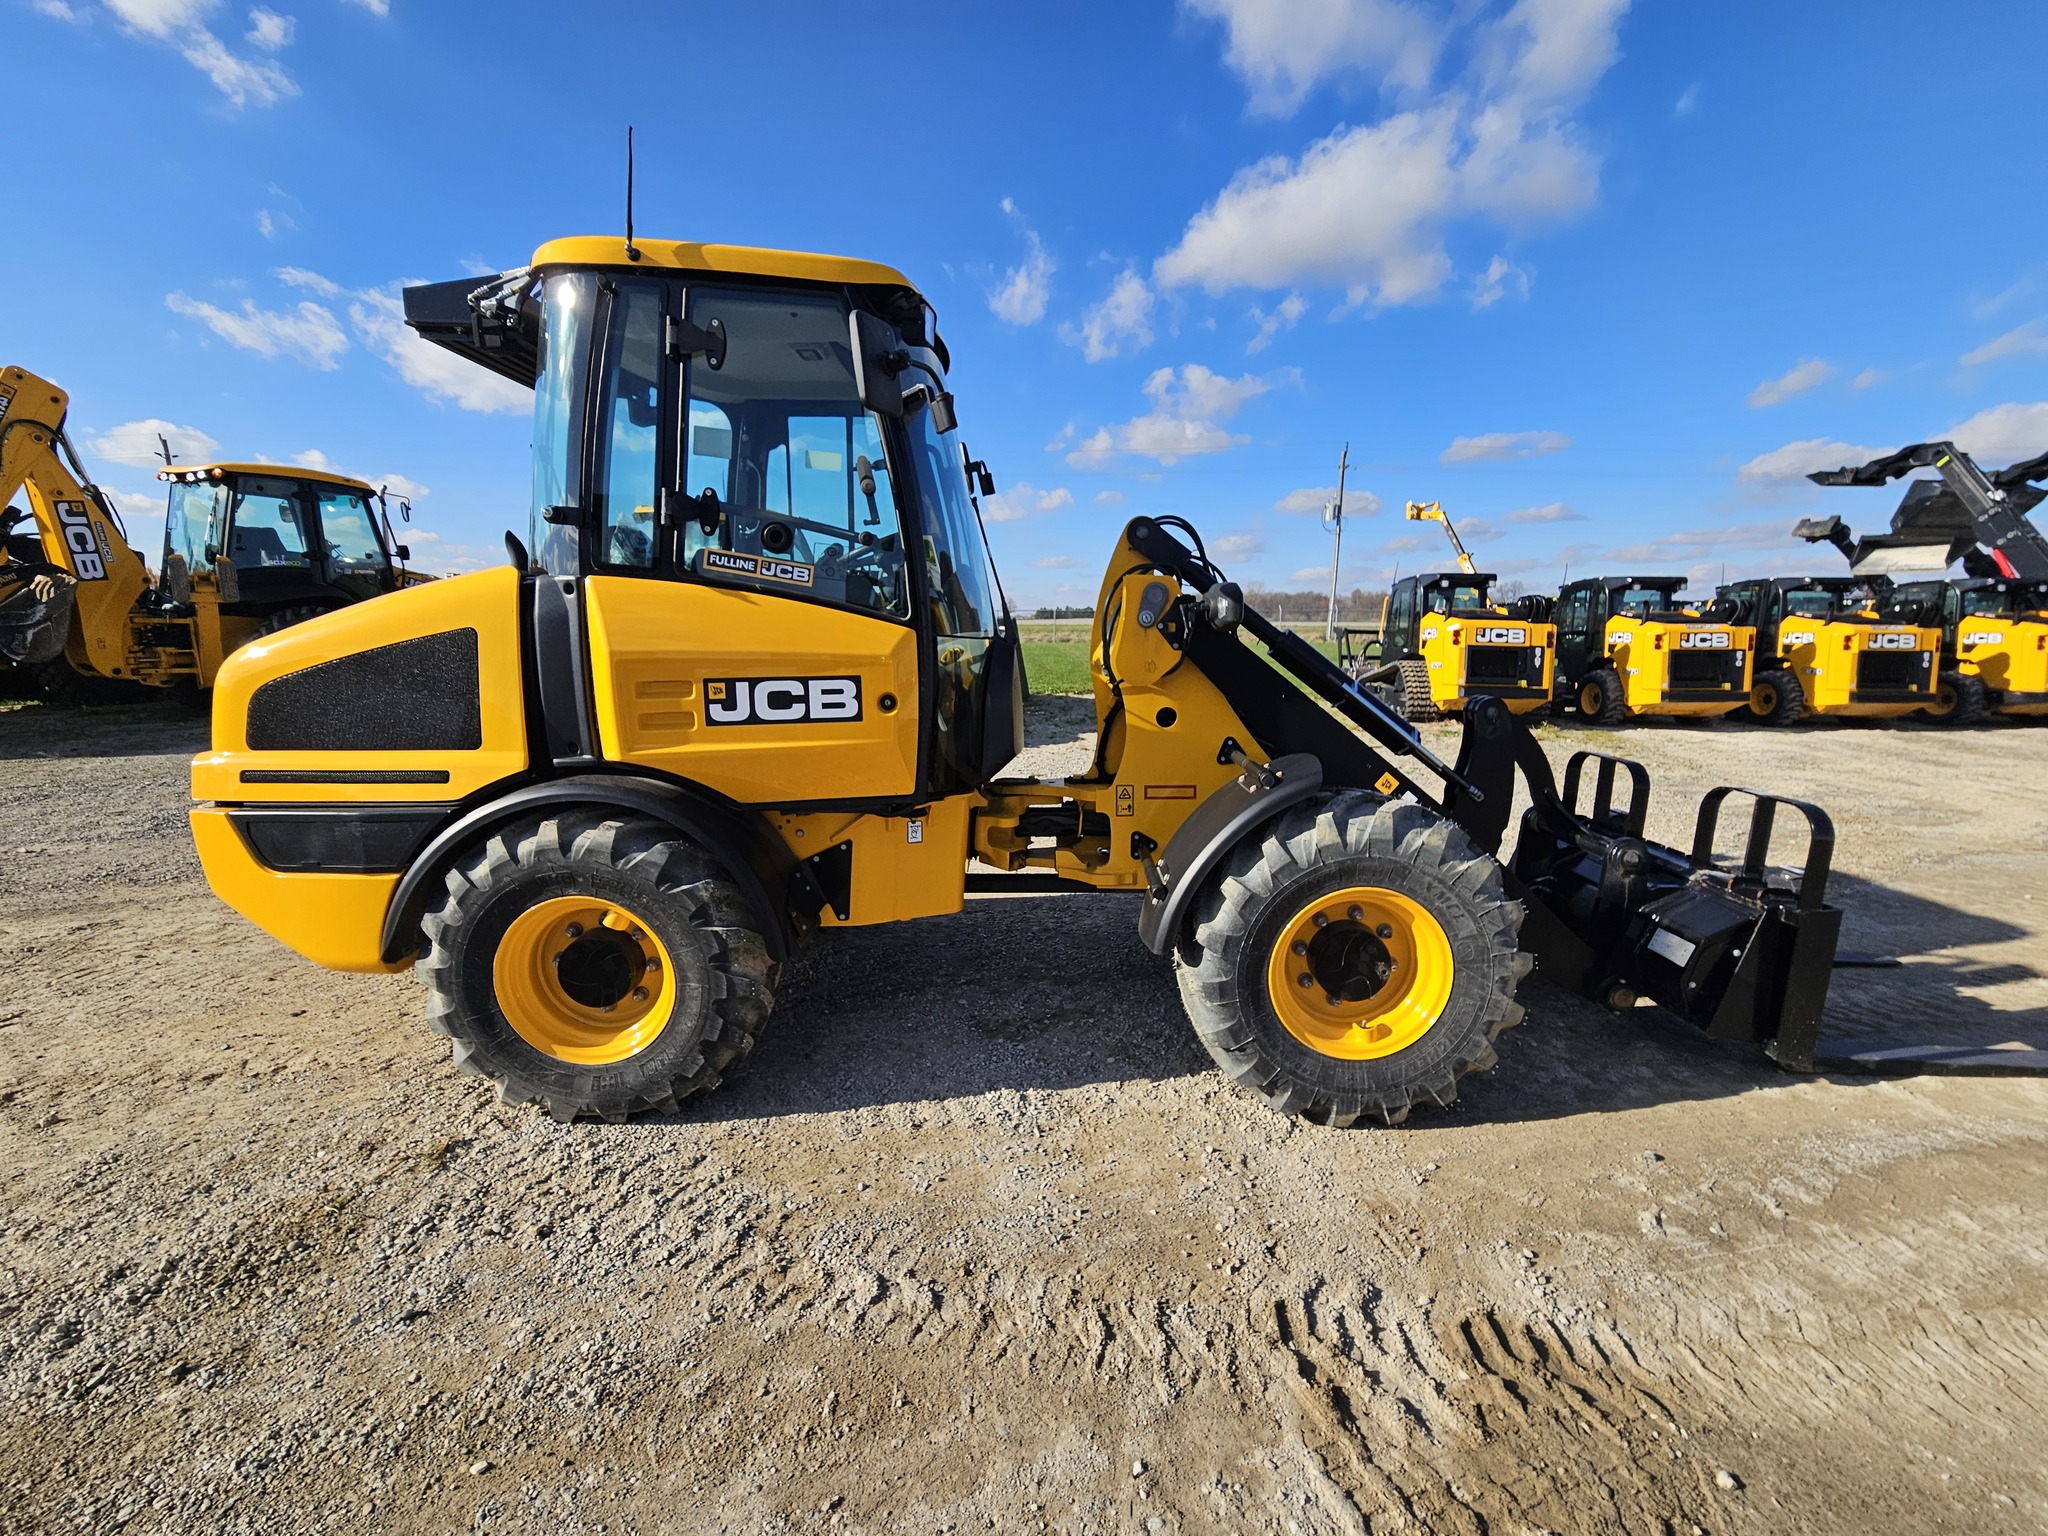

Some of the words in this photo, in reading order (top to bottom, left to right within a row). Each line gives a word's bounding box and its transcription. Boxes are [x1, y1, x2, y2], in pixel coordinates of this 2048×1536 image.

[57, 502, 104, 580] JCB
[102, 541, 114, 562] JCB
[709, 554, 756, 572] FULLINE
[760, 561, 810, 583] JCB
[1421, 628, 1437, 640] JCB
[1476, 628, 1526, 644] JCB
[1608, 632, 1633, 644] JCB
[1680, 632, 1730, 648] JCB
[1782, 632, 1815, 644] JCB
[1868, 633, 1916, 649] JCB
[1962, 632, 2003, 645] JCB
[709, 679, 859, 722] JCB
